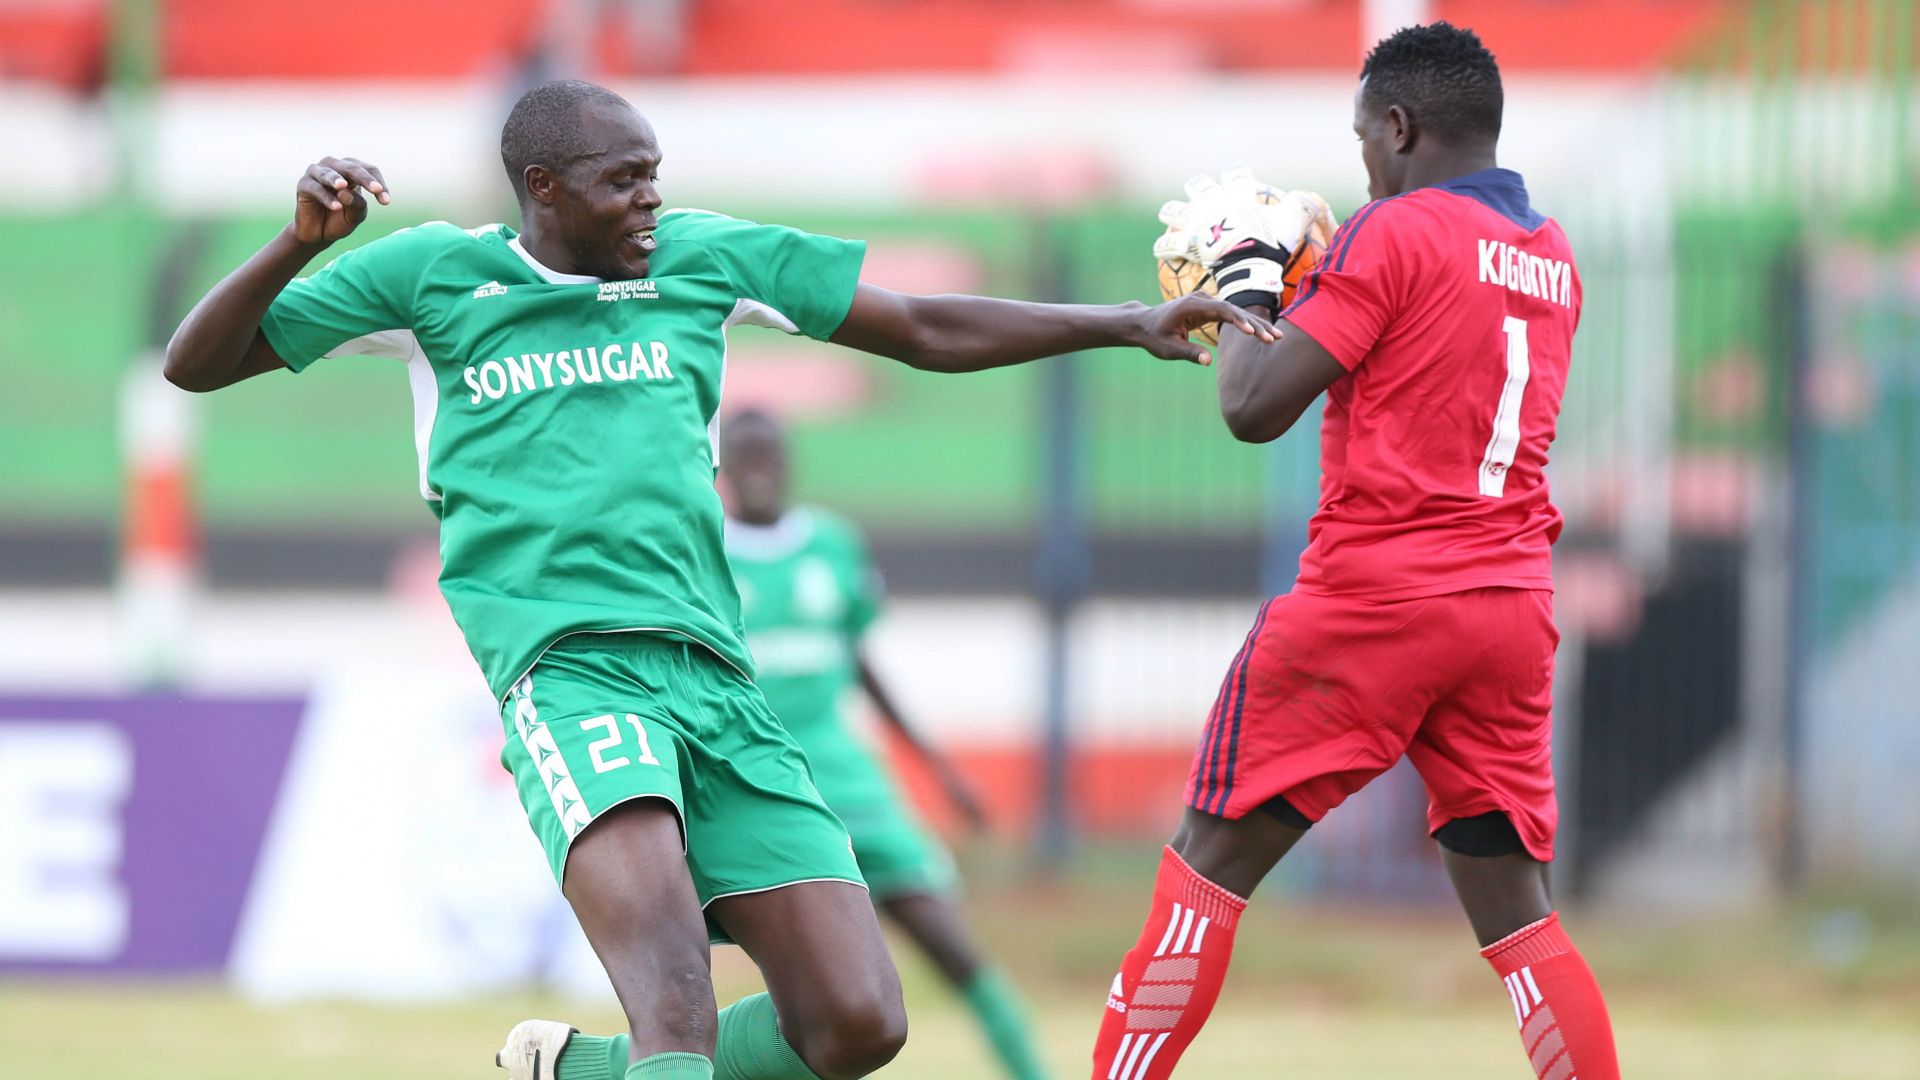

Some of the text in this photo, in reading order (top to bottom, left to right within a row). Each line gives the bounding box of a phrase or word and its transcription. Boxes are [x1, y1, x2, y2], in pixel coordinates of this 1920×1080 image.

[472, 285, 508, 299] SELECT
[596, 292, 619, 302] Simply
[598, 280, 656, 294] SONYSUGAR
[1478, 238, 1571, 309] KIGONYA
[463, 341, 675, 405] SONYSUGAR
[1478, 315, 1530, 498] 1
[579, 713, 661, 774] 21
